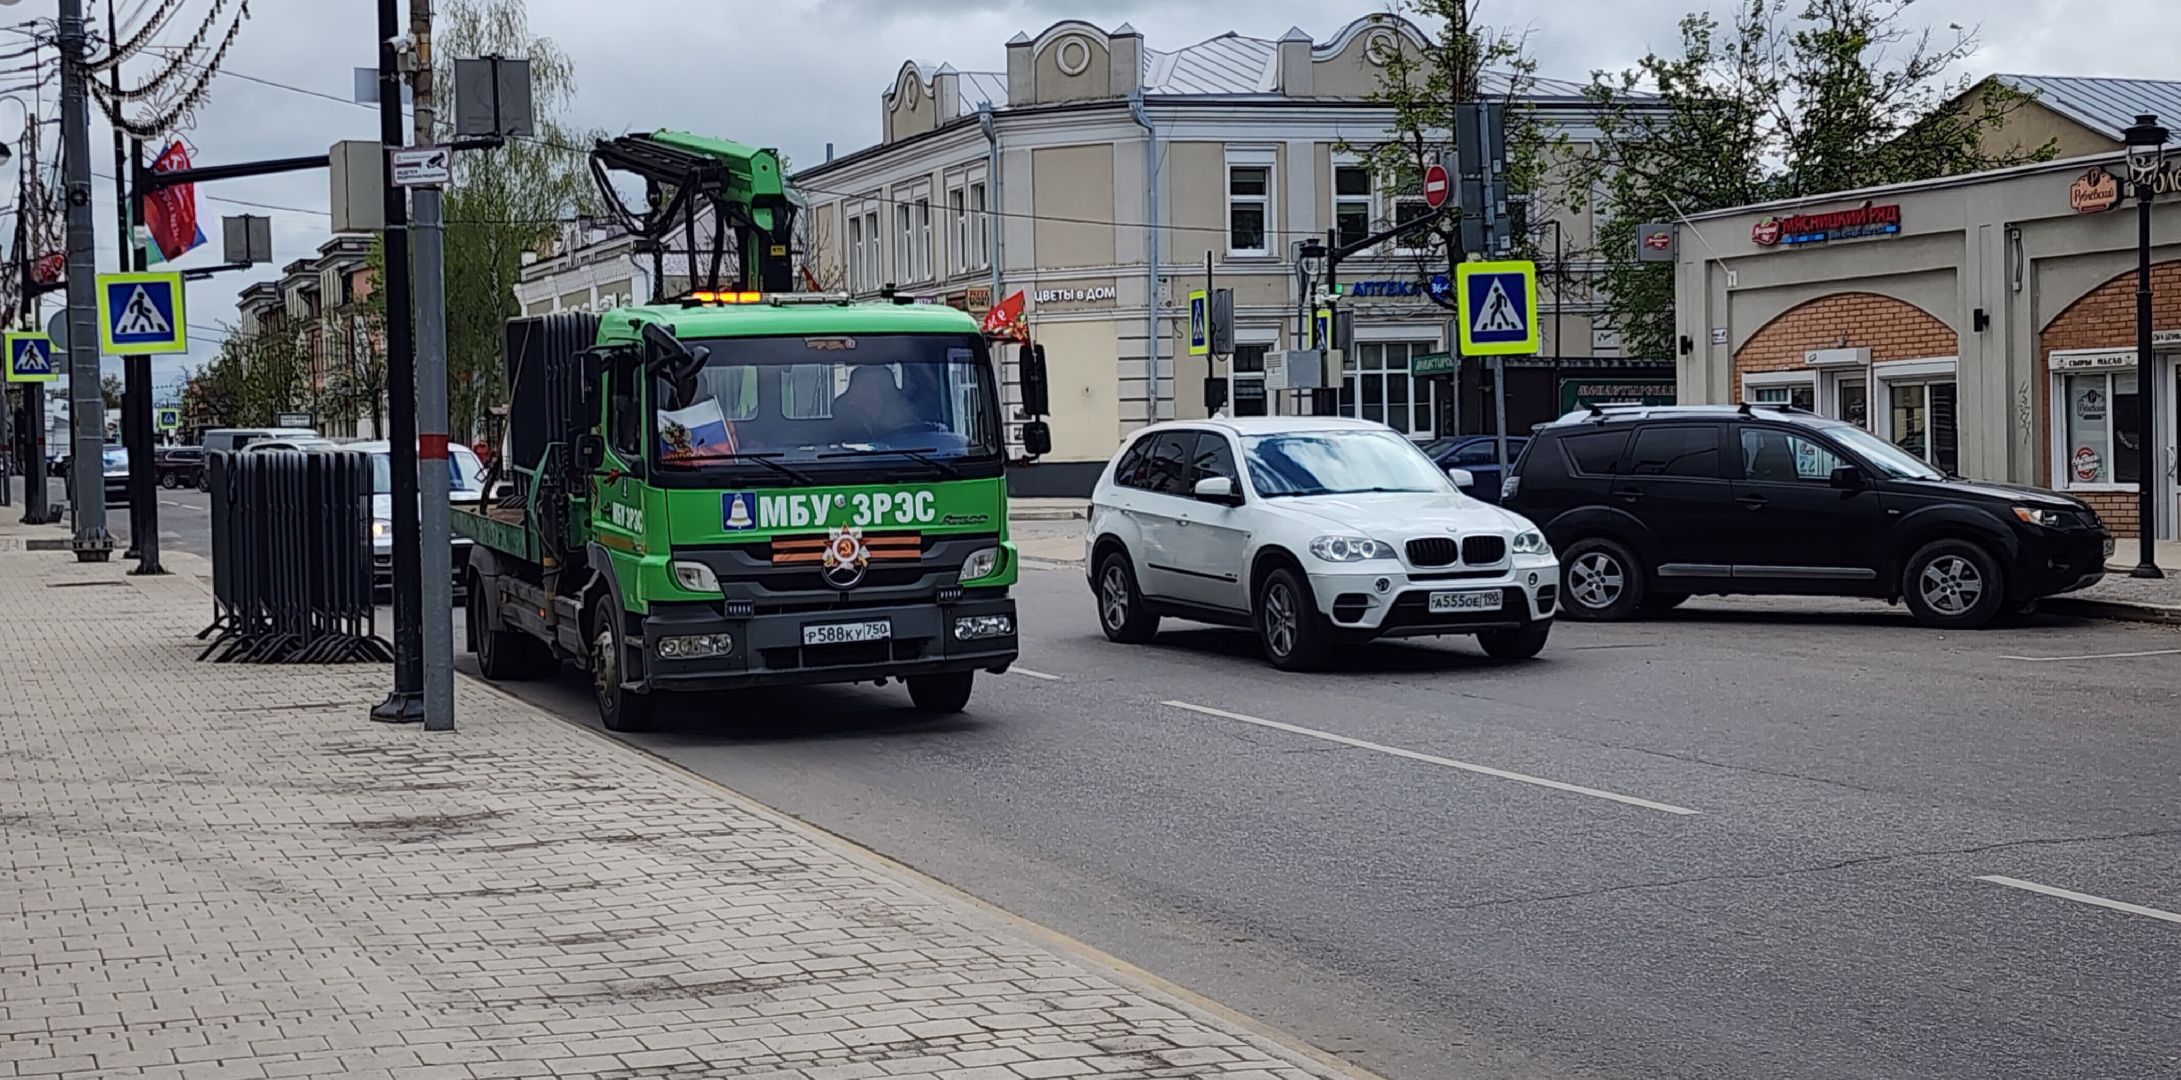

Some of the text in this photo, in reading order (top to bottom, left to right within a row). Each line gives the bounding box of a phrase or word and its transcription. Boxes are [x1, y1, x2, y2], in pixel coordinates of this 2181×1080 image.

[1783, 206, 1898, 232] МЯСНИЦКИЙ РЯД
[1034, 289, 1074, 303] ЦВЕТЫ
[1086, 287, 1115, 301] ДОМ
[1352, 281, 1422, 297] АПТЕКА
[759, 491, 936, 528] МБУ ЗРЭС
